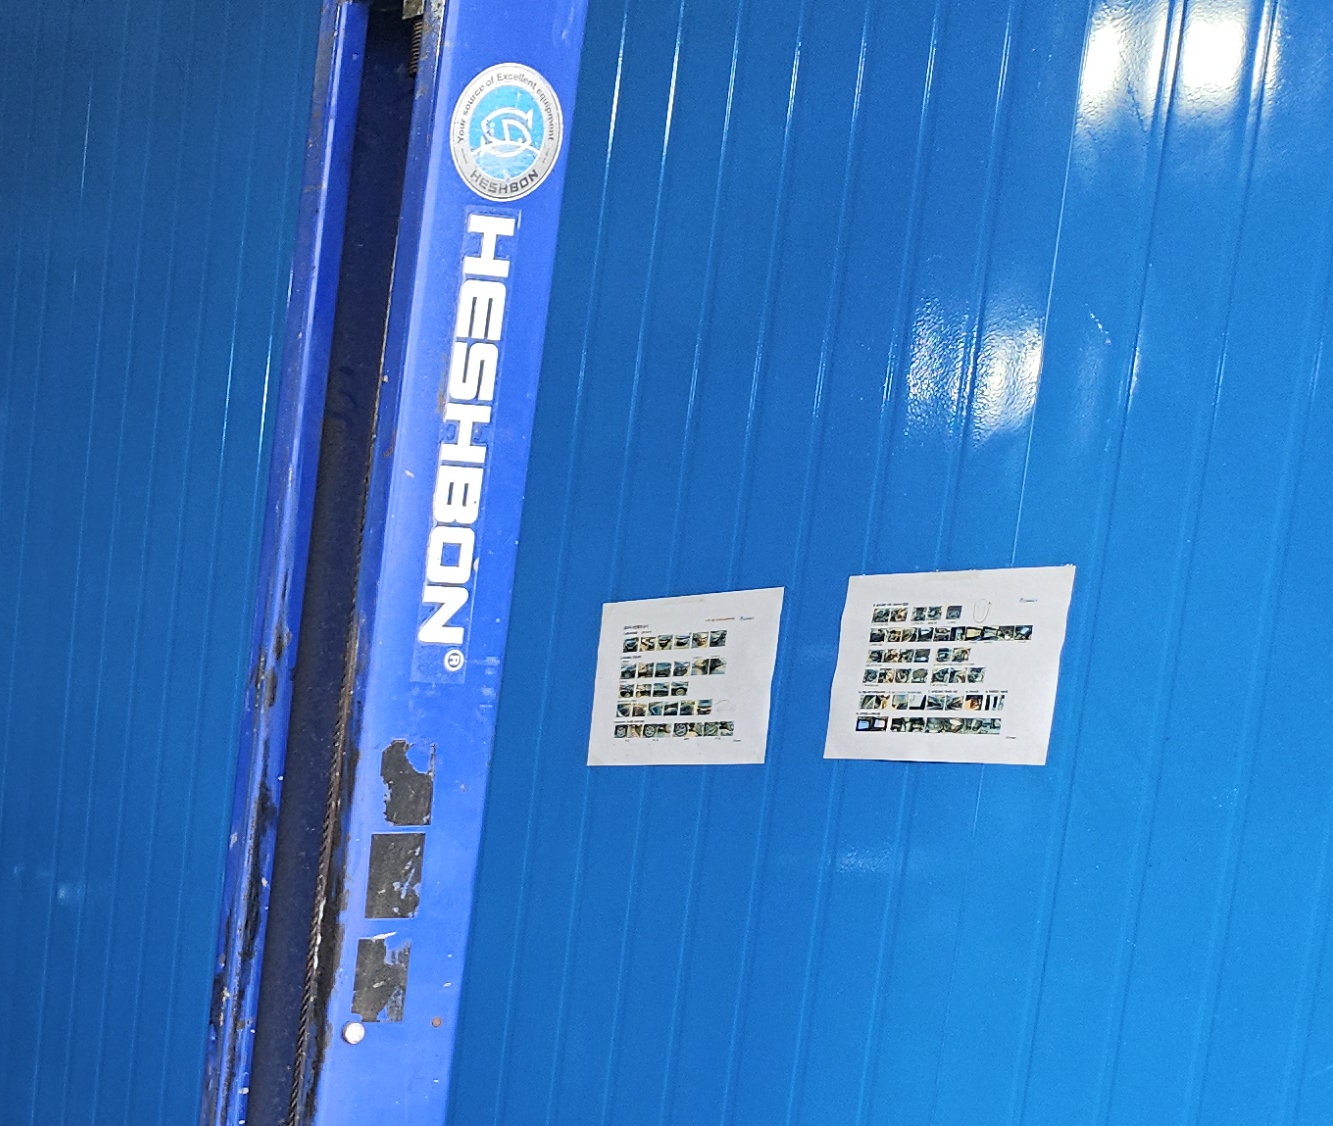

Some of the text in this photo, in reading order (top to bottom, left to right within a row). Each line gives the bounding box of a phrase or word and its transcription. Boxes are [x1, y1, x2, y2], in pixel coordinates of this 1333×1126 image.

[457, 73, 555, 144] Your source of Excellent equipment
[470, 169, 539, 194] HESHBON
[417, 213, 516, 645] HESHBON
